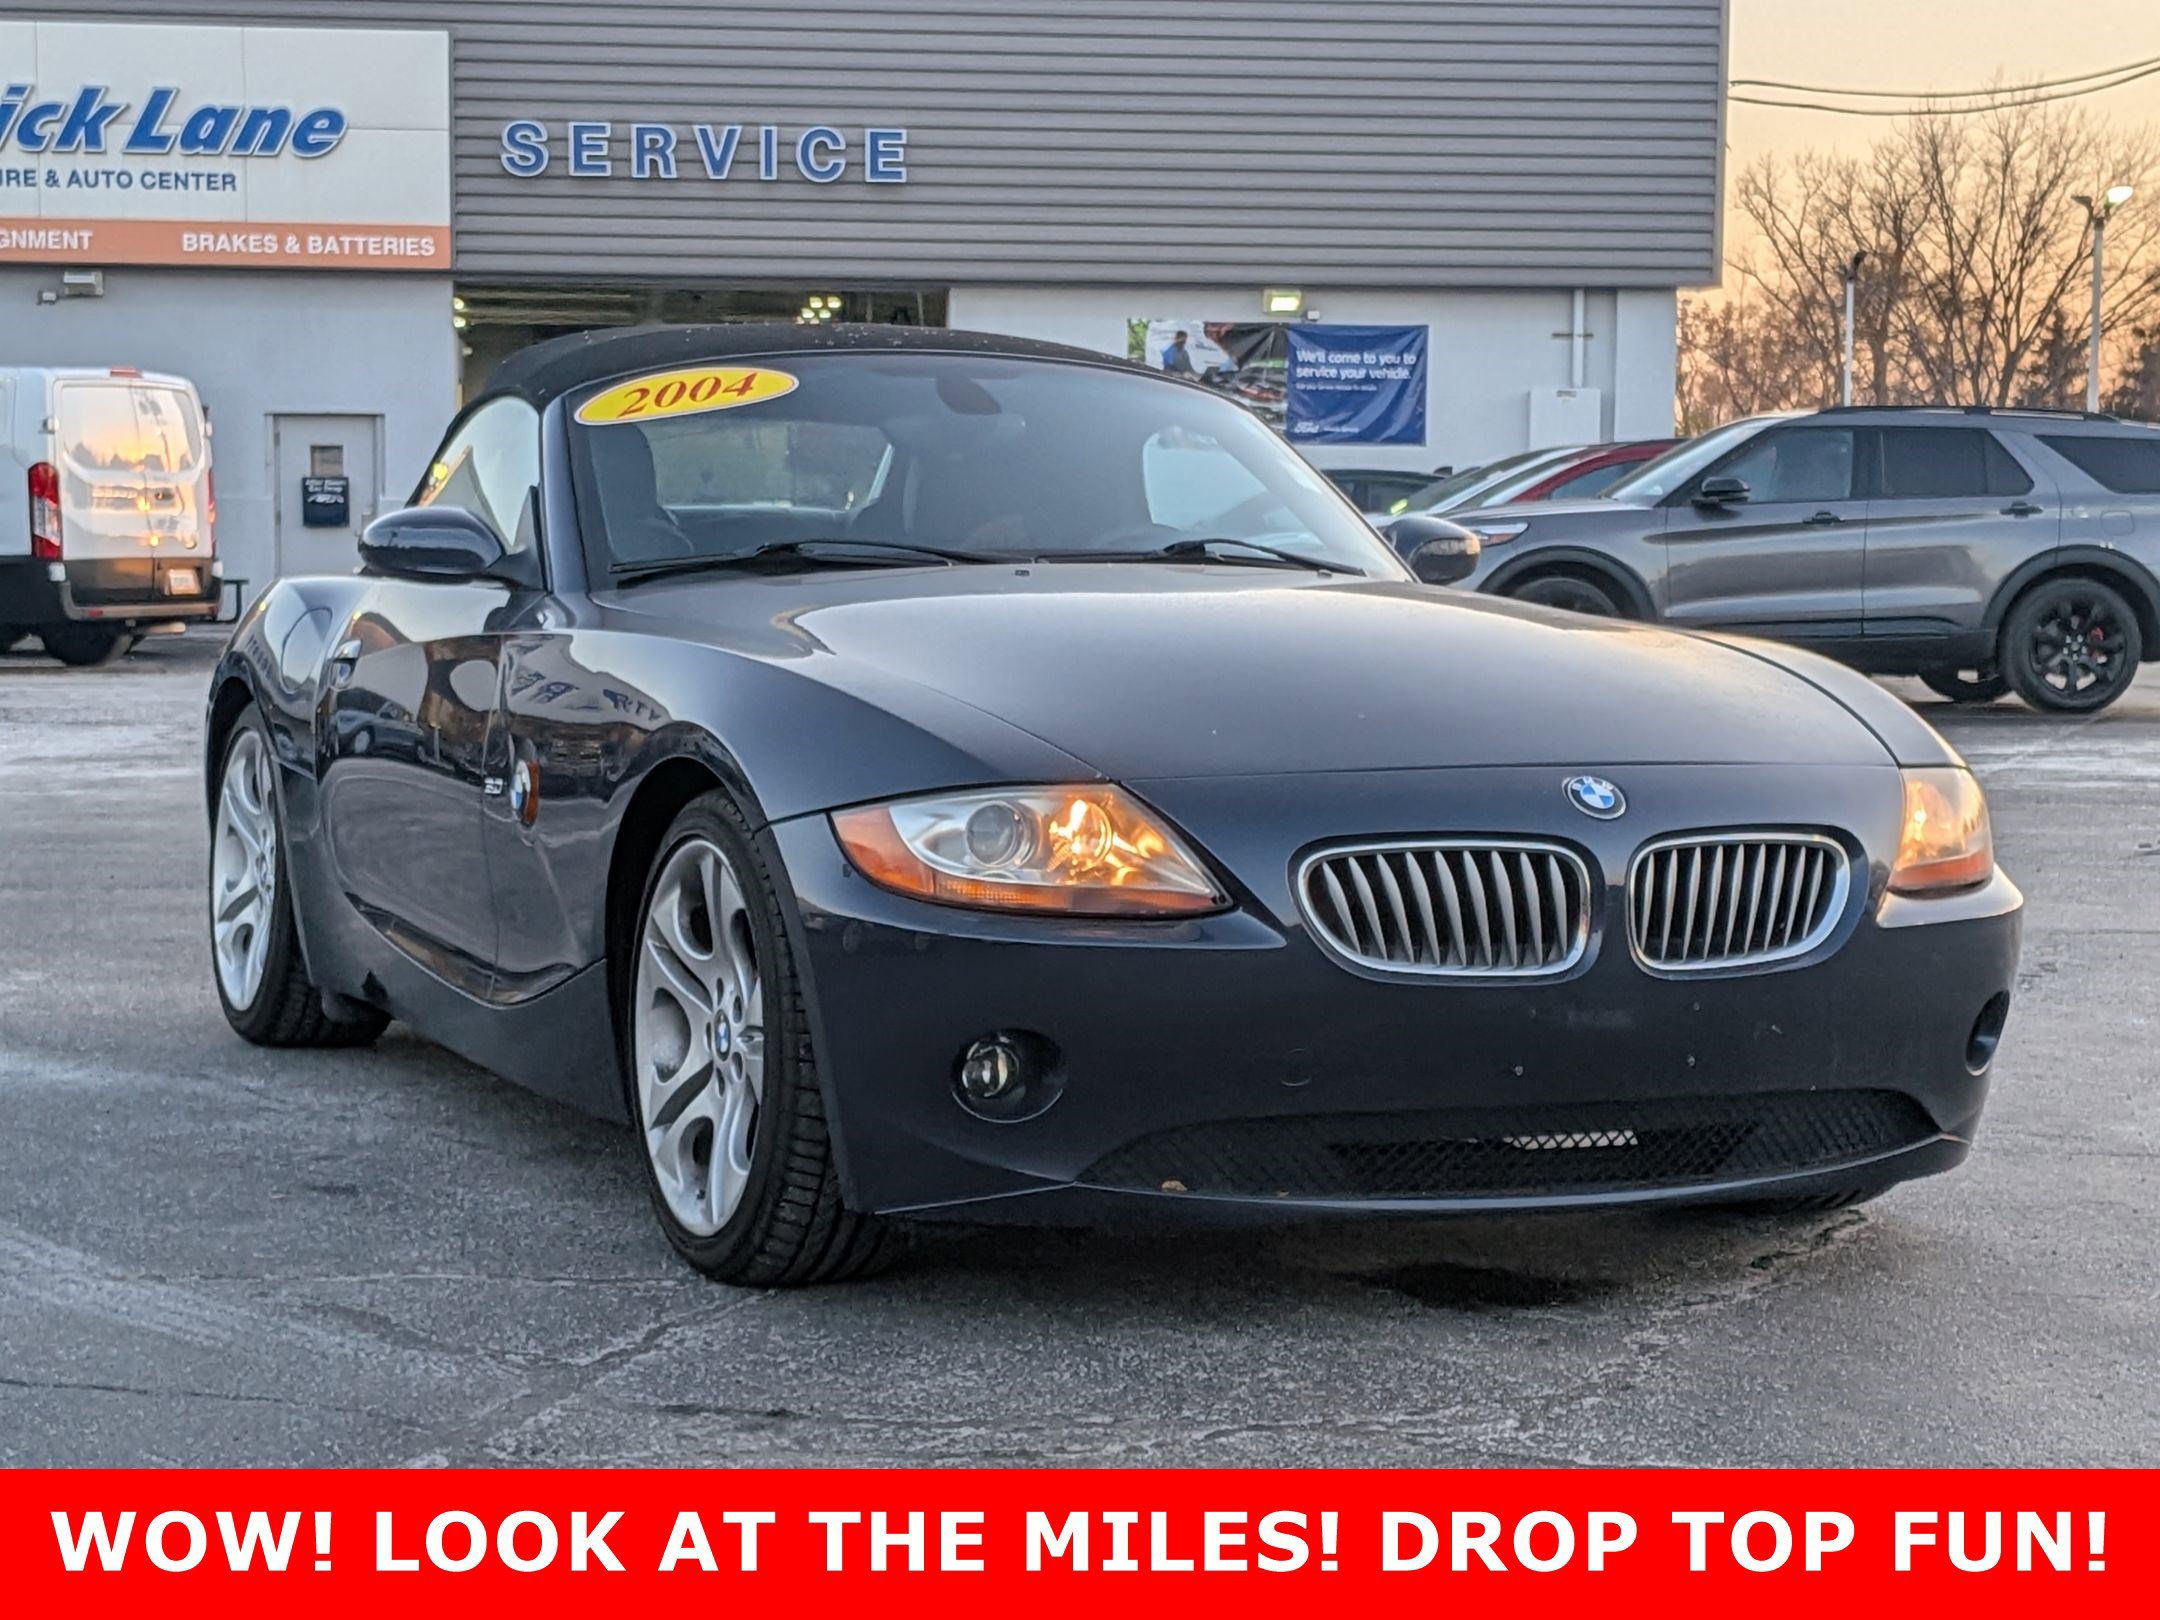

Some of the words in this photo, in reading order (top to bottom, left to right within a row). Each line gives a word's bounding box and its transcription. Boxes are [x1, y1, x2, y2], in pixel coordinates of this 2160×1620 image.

[123, 86, 349, 159] Lane
[501, 119, 908, 184] SERVICE
[45, 169, 61, 188] &
[67, 169, 134, 190] AUTO
[141, 171, 238, 192] CENTER
[182, 233, 279, 255] BRAKES
[284, 235, 301, 255] &
[307, 235, 436, 257] BATTERIES
[1296, 350, 1326, 363] We'll
[1327, 353, 1361, 364] come
[1363, 351, 1377, 365] to
[1379, 354, 1401, 366] you
[1403, 353, 1417, 365] to
[1296, 366, 1338, 378] service
[1340, 368, 1367, 380] your
[617, 371, 758, 418] 2004
